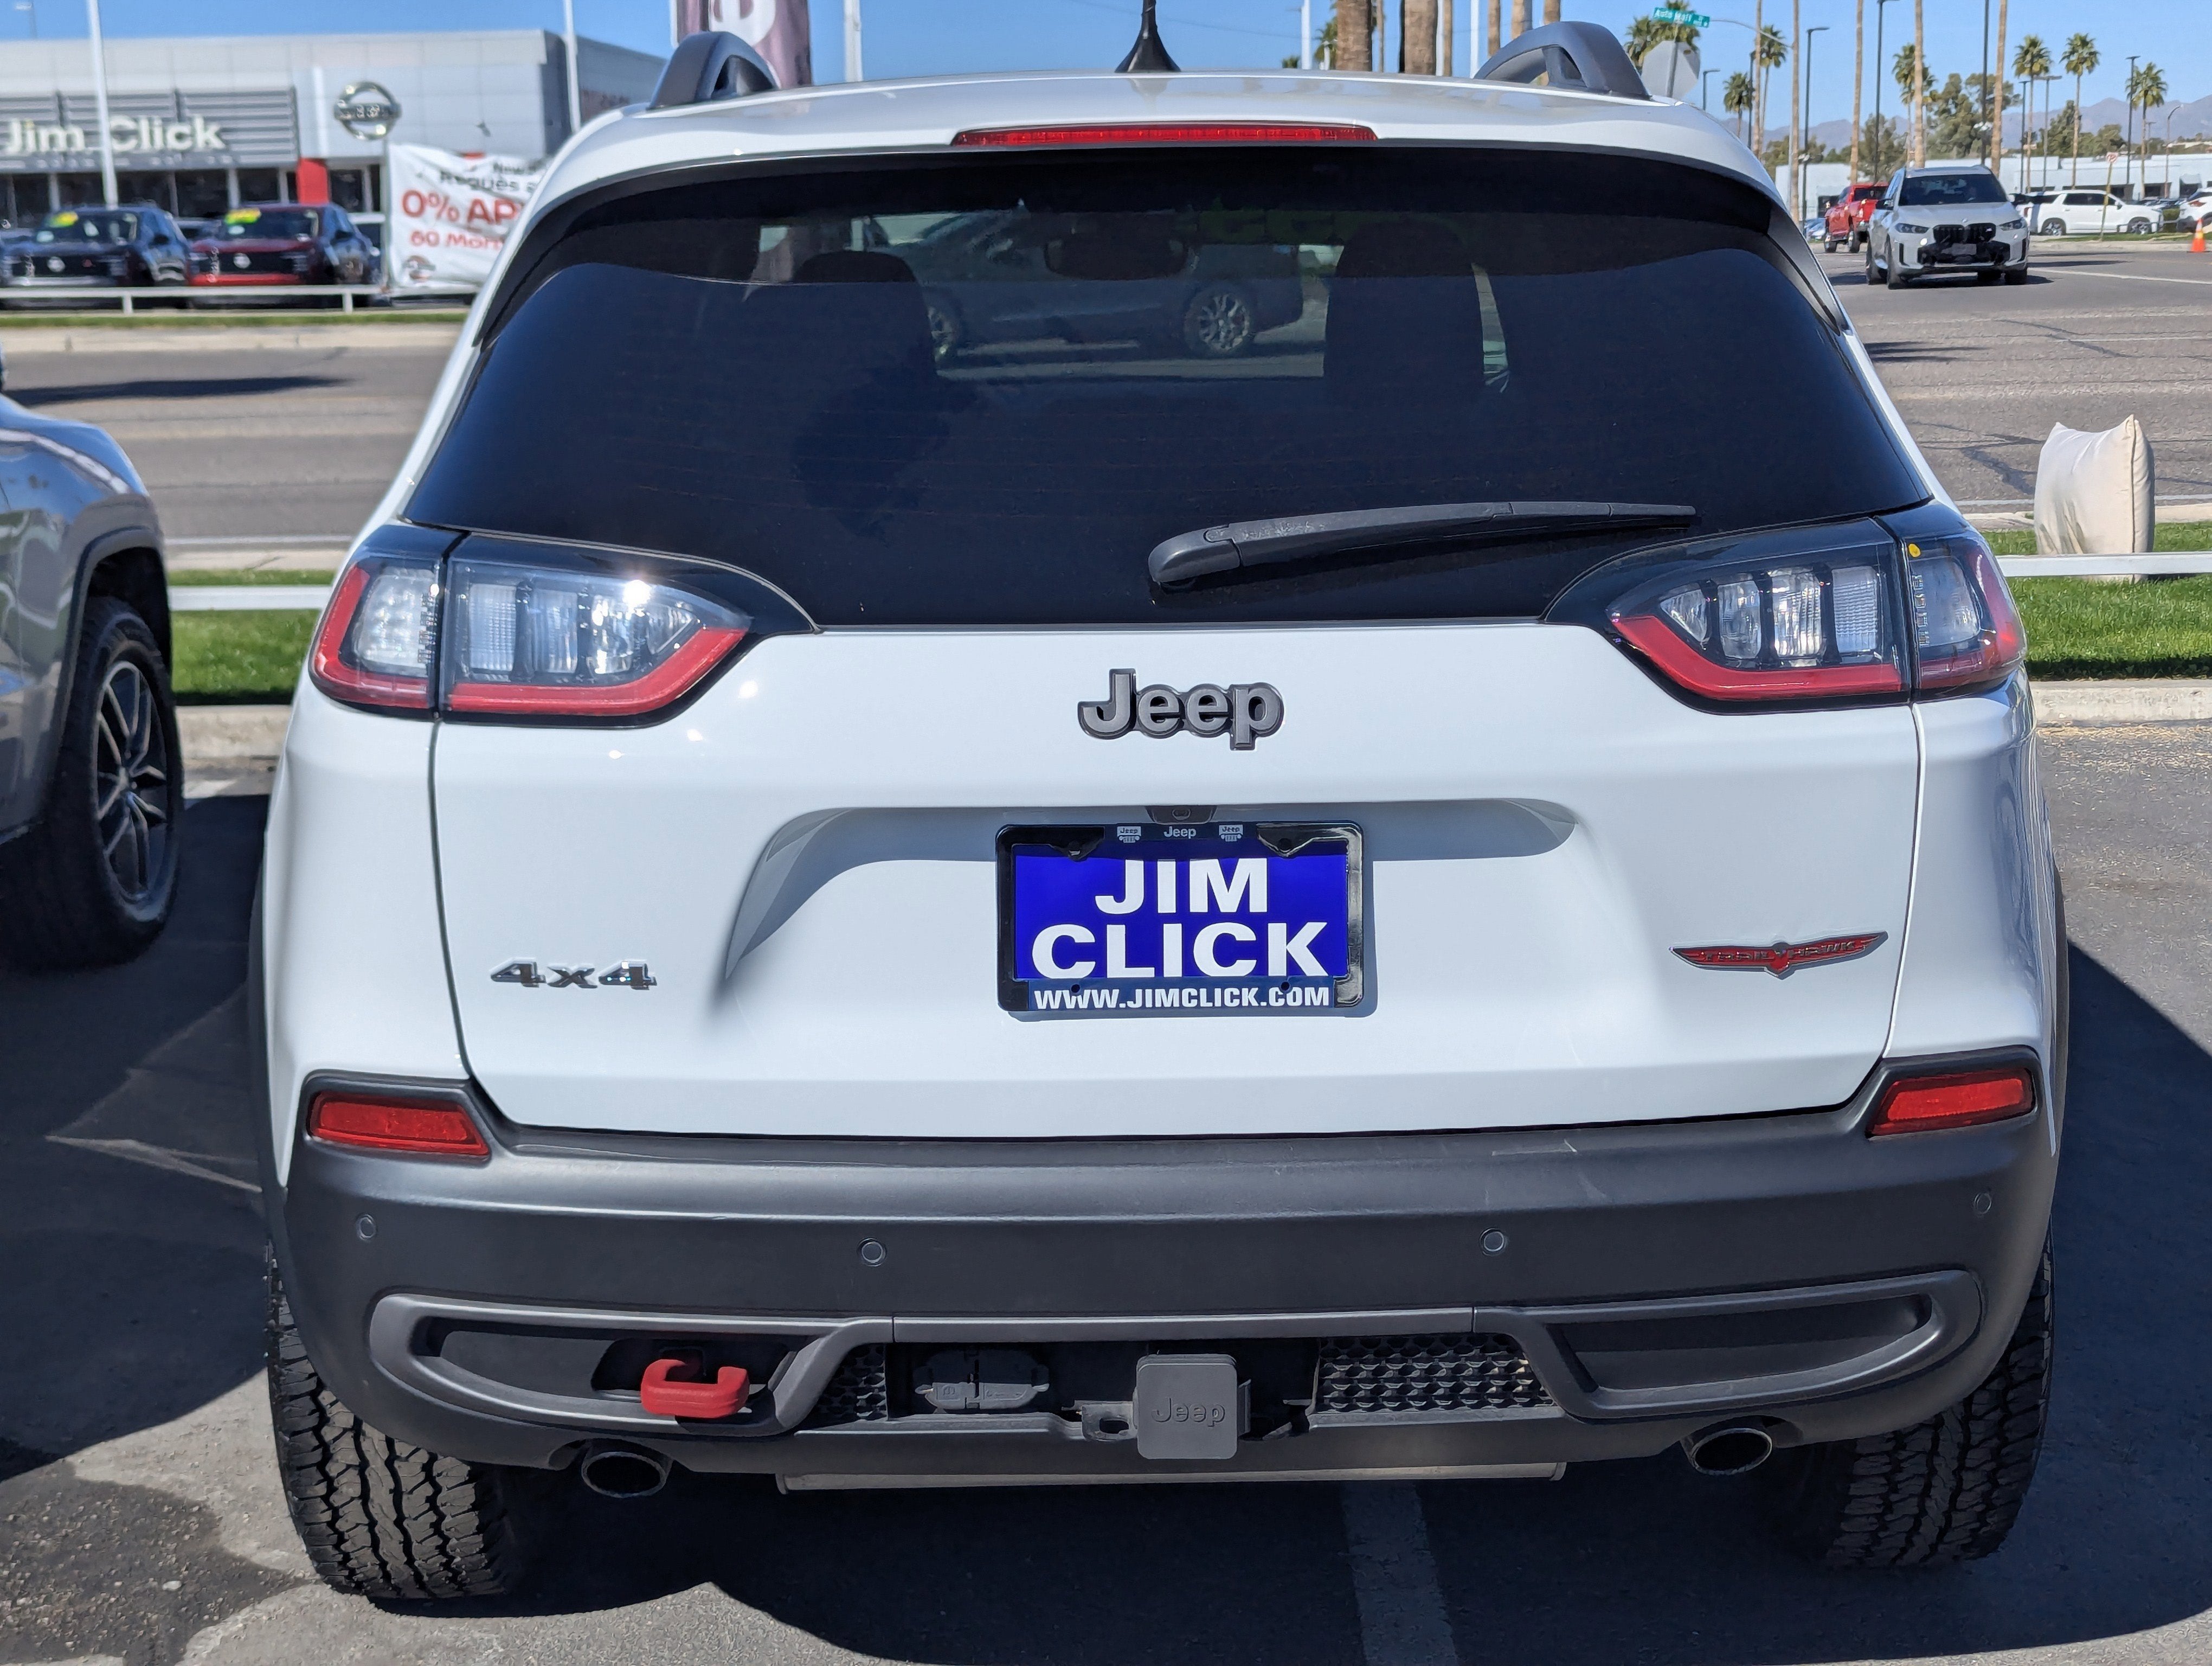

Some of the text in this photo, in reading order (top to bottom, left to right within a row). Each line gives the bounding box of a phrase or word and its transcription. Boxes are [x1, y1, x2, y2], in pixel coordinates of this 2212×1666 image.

[6, 114, 226, 153] Jim Click
[401, 189, 525, 225] 0% AP
[1078, 668, 1284, 751] Jeep
[1163, 826, 1197, 839] Jeep
[1095, 858, 1268, 914] JIM
[1032, 921, 1329, 979] CLICK
[489, 957, 658, 991] 4x4
[1034, 986, 1329, 1009] WWW.JIMCLICK.COM
[1151, 1396, 1226, 1427] Jeep
